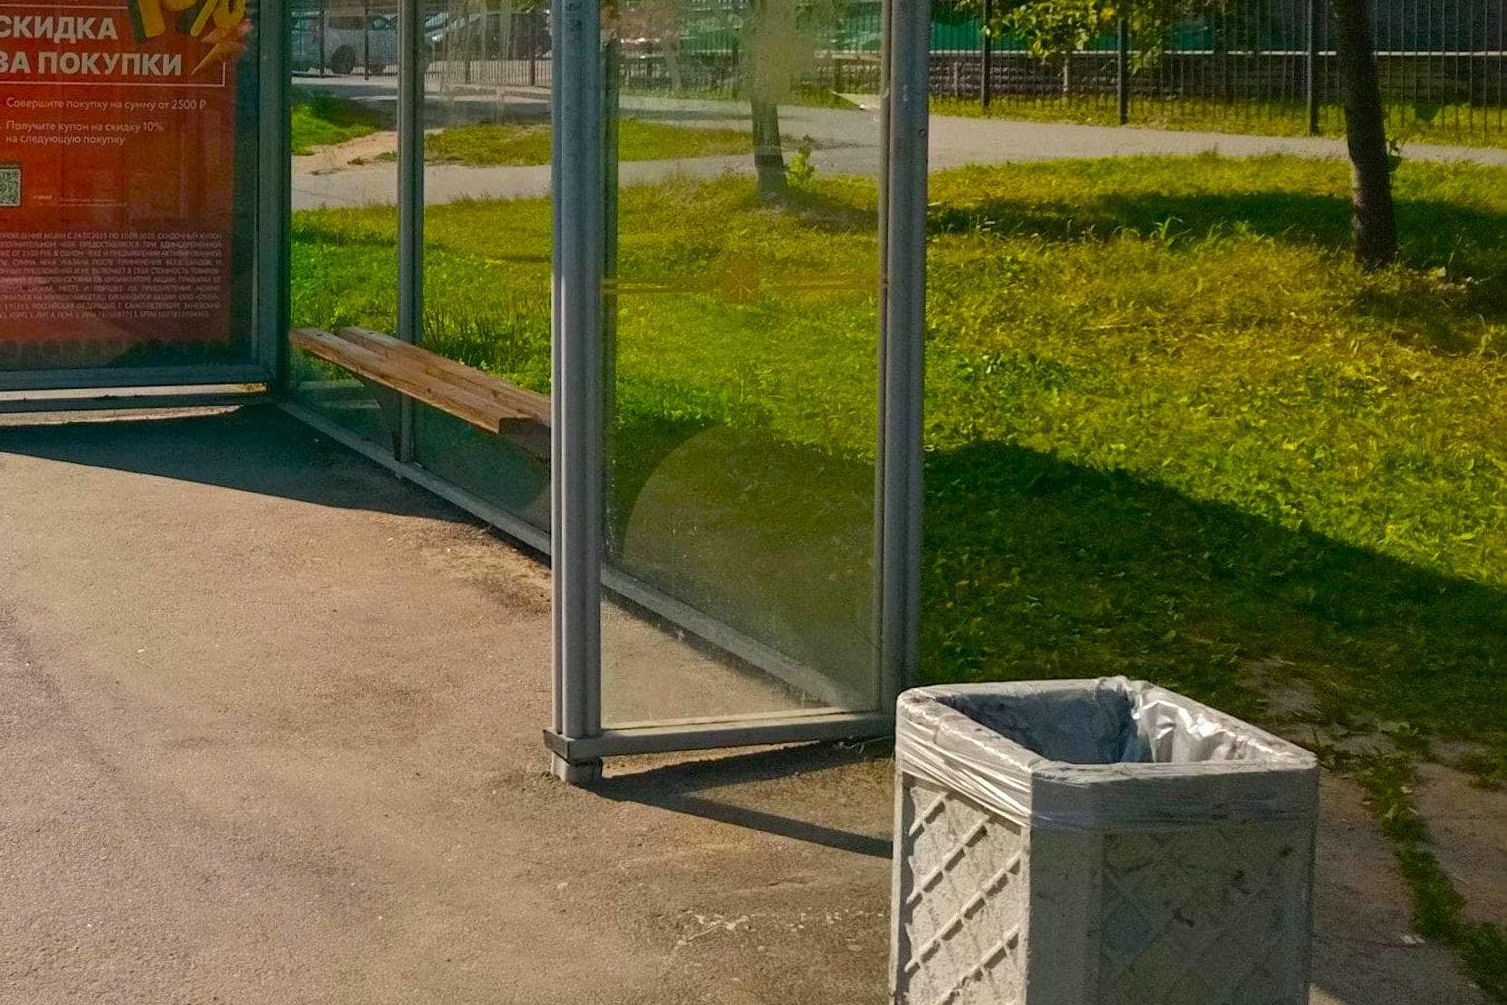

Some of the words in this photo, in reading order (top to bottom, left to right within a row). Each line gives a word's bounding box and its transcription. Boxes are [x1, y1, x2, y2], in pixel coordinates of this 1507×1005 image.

[38, 51, 182, 77] ПОКУПКИ
[6, 97, 64, 109] Совершите
[66, 100, 108, 111] покупку
[110, 101, 122, 109] на
[124, 101, 156, 112] сумму
[158, 102, 170, 110] от
[172, 99, 197, 110] 2500
[6, 120, 56, 132] Получите
[58, 124, 89, 132] купон
[105, 124, 140, 133] скидку
[143, 121, 164, 132] 10%
[19, 135, 81, 146] следующую
[83, 136, 125, 146] покупку
